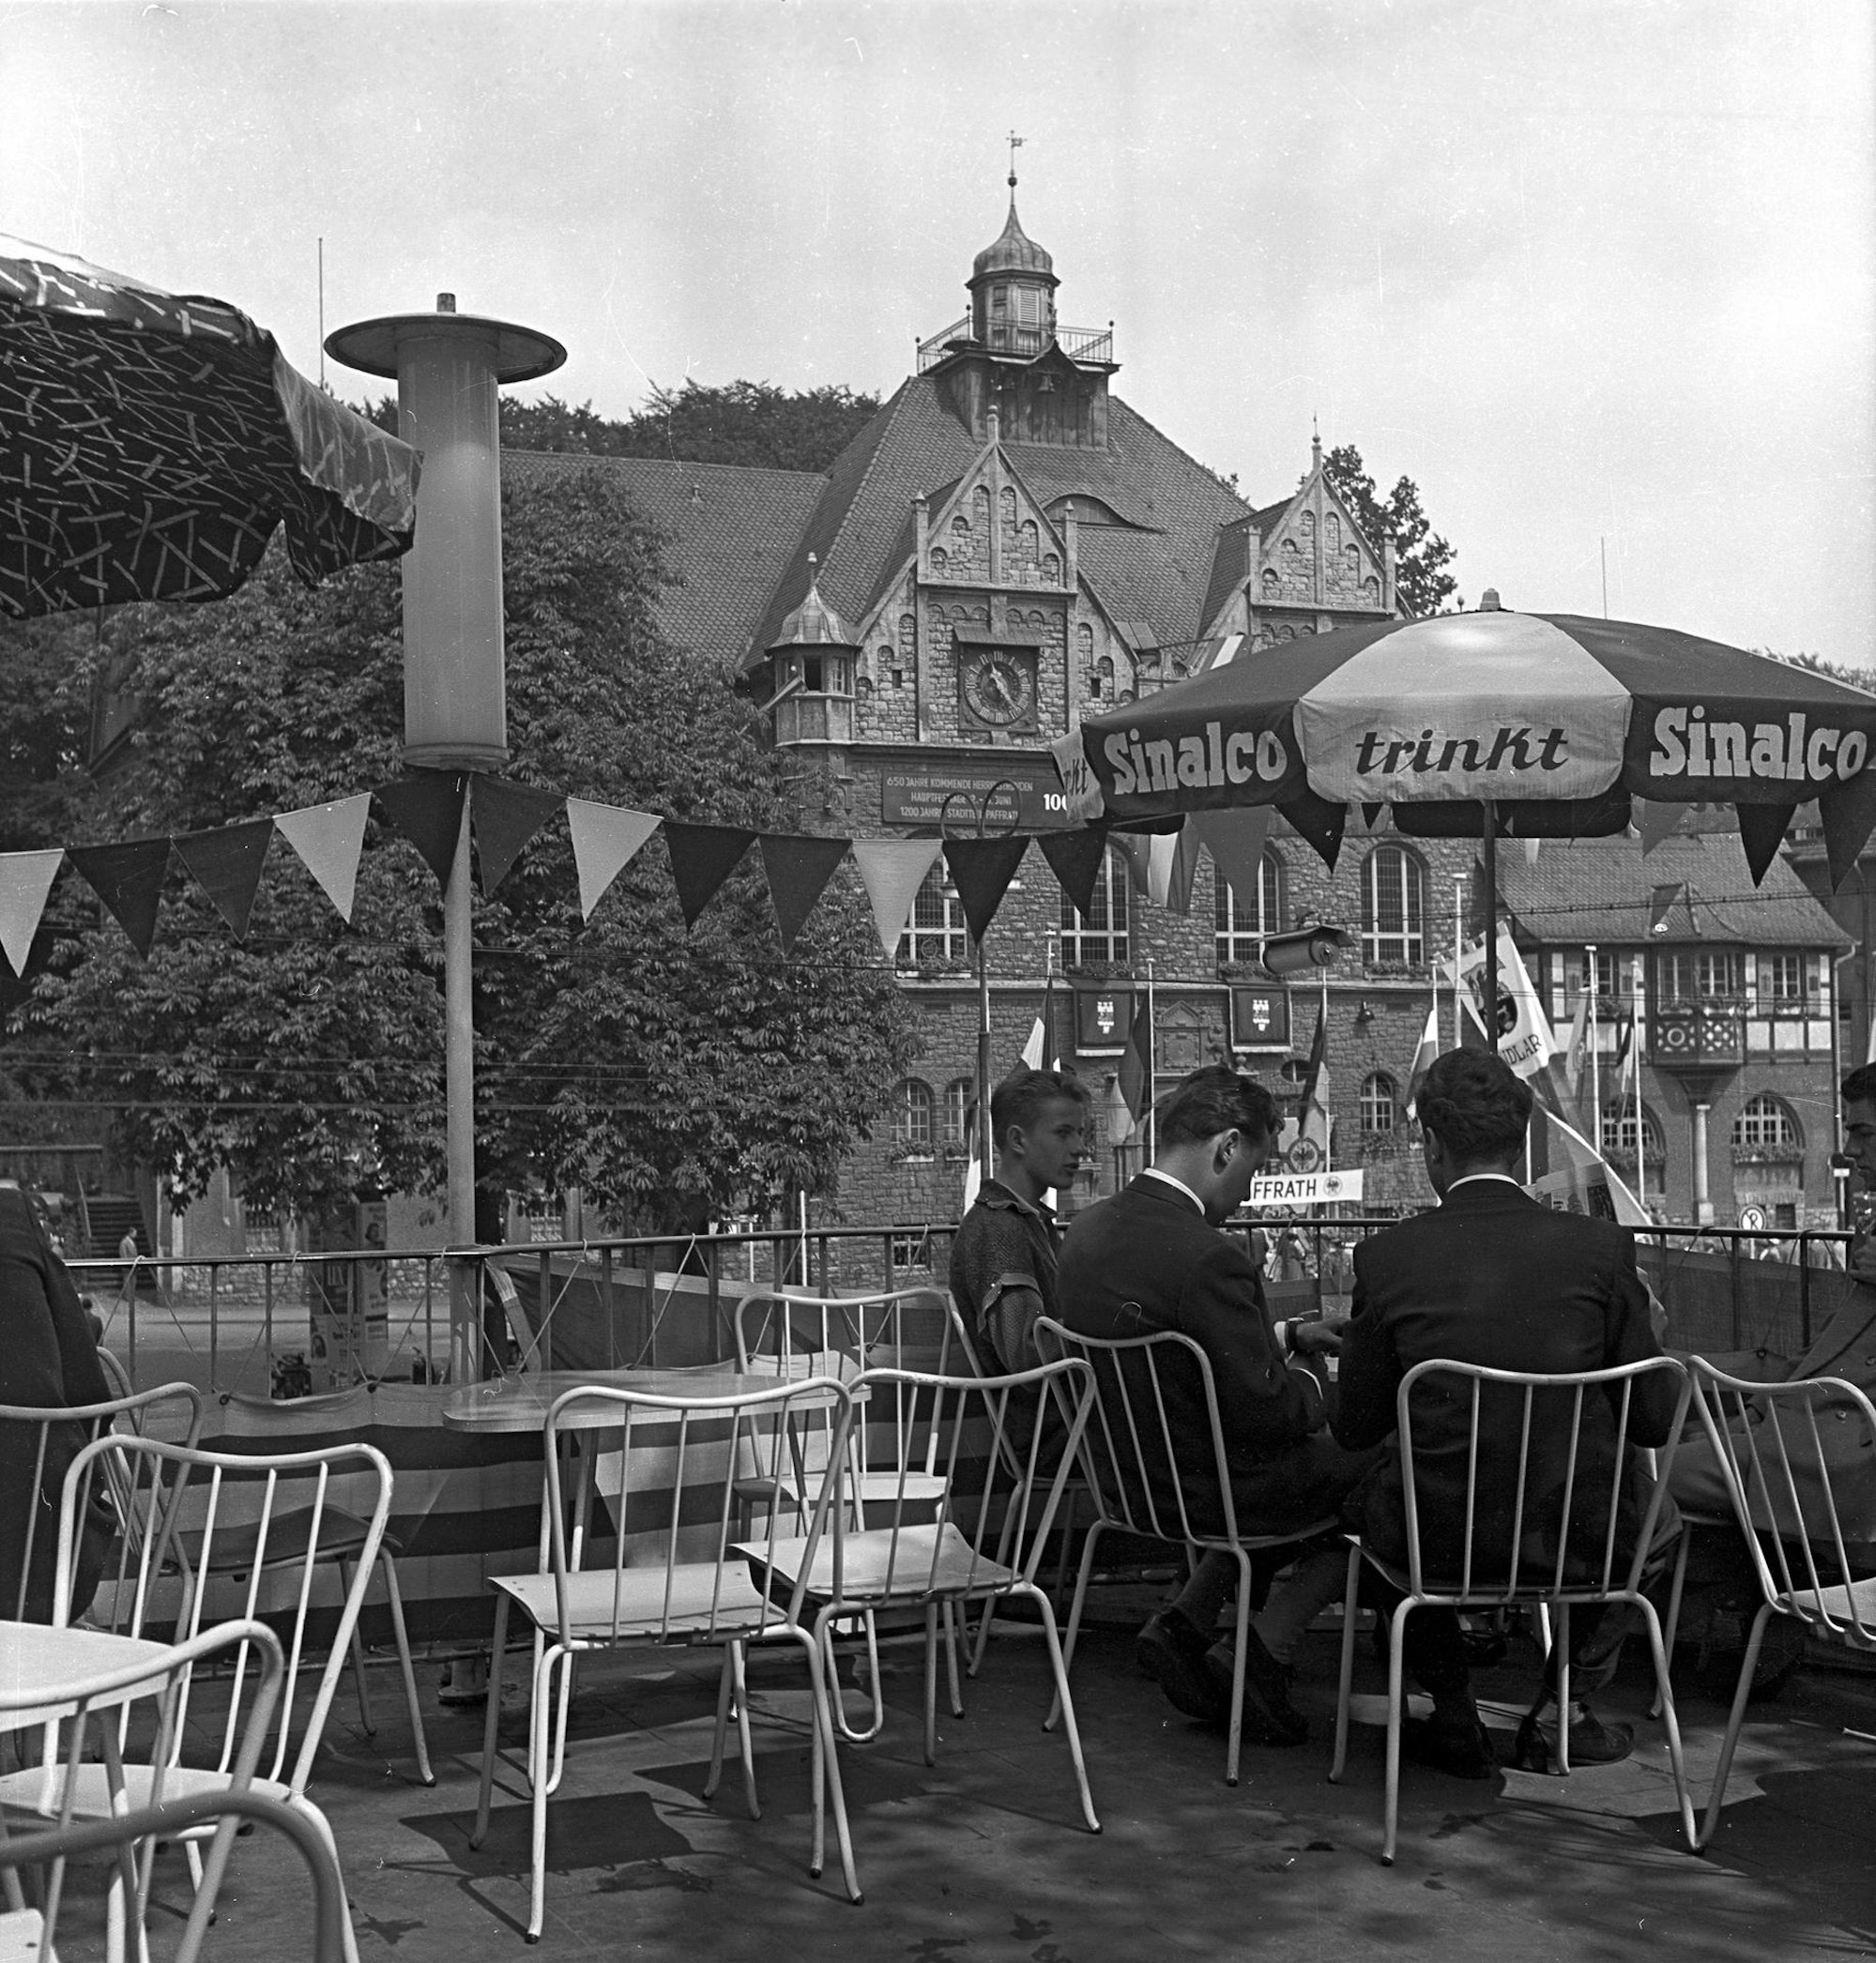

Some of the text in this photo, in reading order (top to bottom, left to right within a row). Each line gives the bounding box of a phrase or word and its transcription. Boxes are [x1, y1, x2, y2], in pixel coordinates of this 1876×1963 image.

[1650, 706, 1868, 781] Sinalco
[1104, 722, 1288, 795] Sinalco
[887, 776, 905, 786] 650
[906, 777, 928, 787] JAHRE
[900, 806, 919, 817] 1200
[1253, 1178, 1317, 1200] FFRATH
